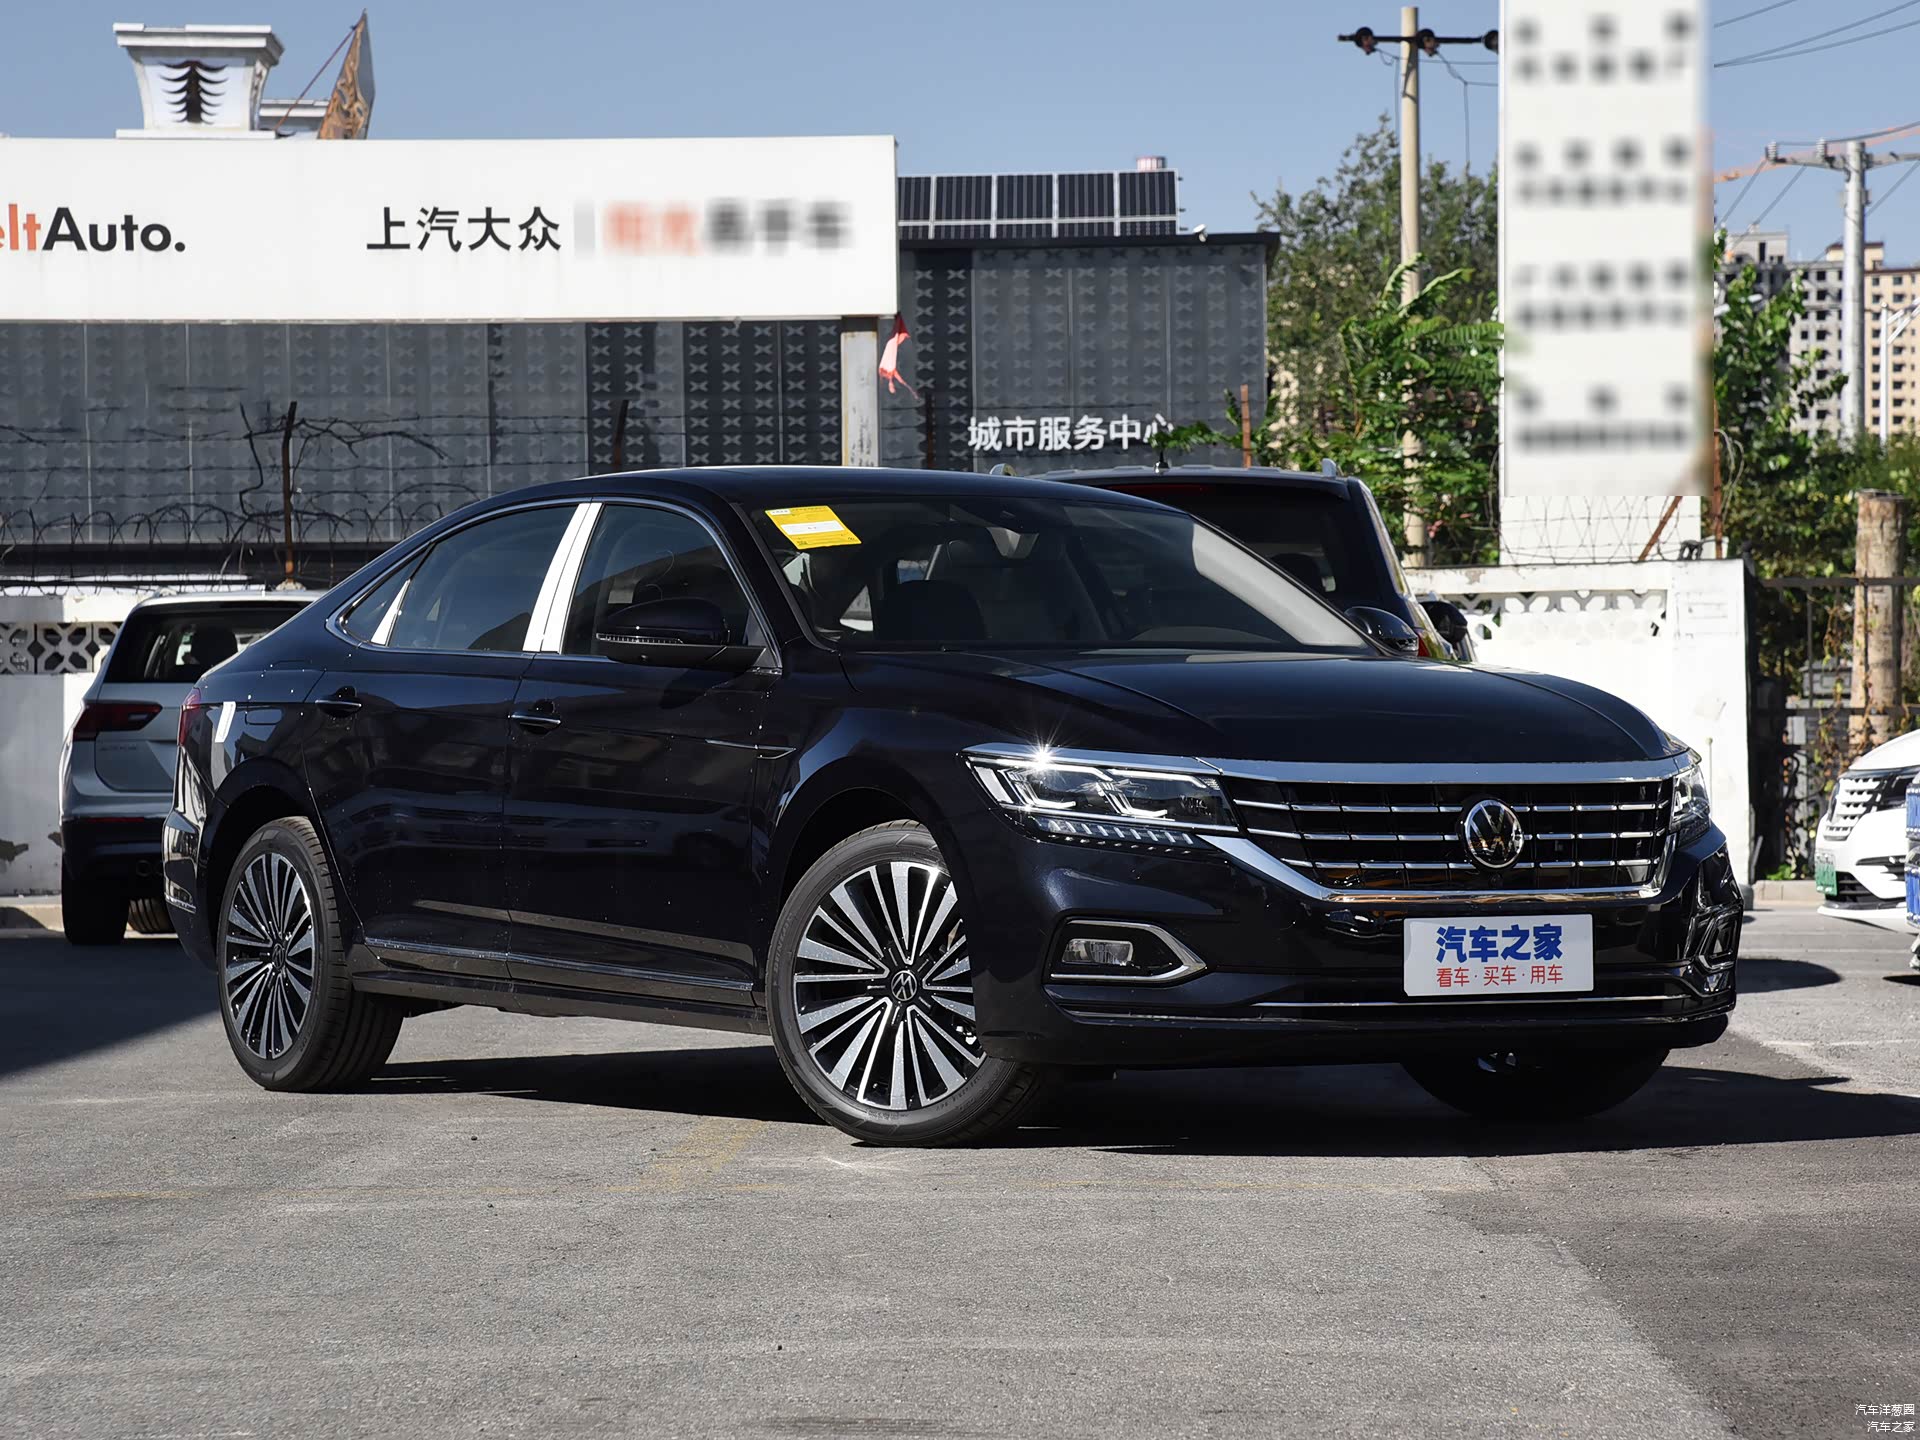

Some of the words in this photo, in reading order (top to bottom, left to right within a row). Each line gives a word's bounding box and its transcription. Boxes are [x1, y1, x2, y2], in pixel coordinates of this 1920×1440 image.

[0, 203, 187, 253] ltAuto.
[366, 205, 562, 253] 上汽大众
[1435, 922, 1564, 963] 汽车之家
